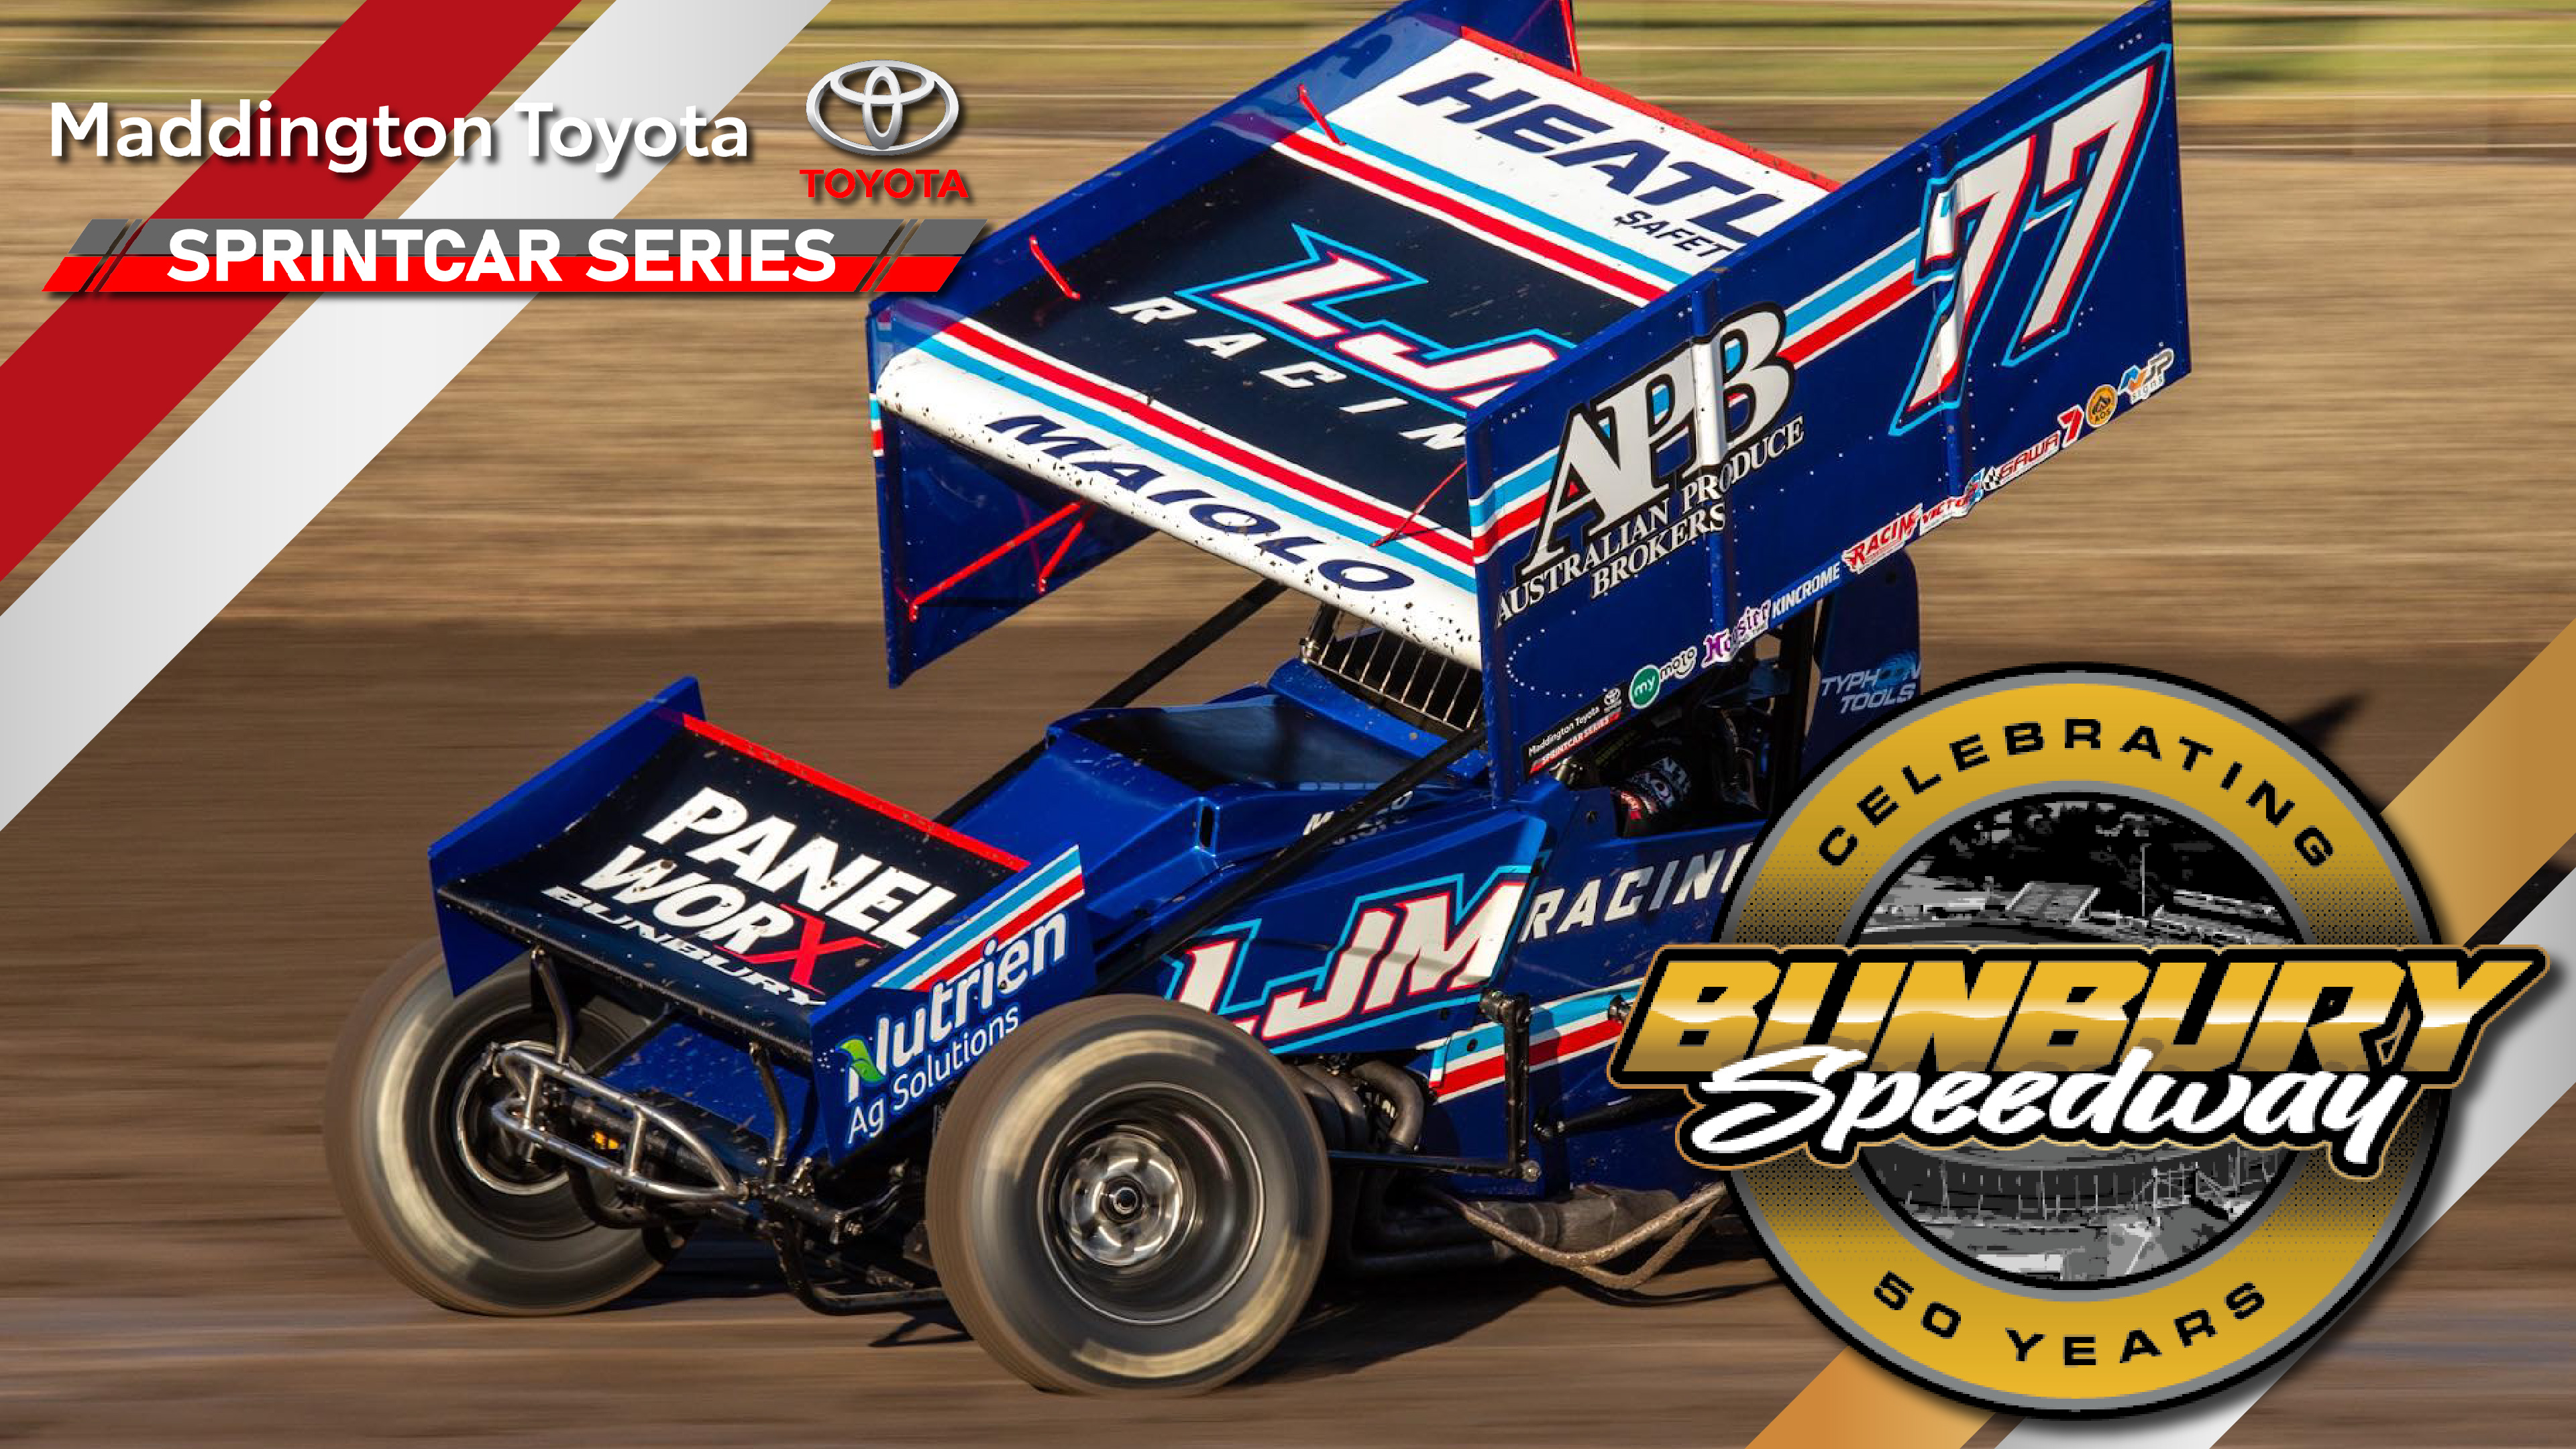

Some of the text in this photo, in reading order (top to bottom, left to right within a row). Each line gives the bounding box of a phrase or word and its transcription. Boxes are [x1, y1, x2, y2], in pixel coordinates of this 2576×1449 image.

[1613, 209, 1734, 260] SAFET
[1897, 54, 2161, 424] 77
[983, 414, 1415, 592] MAIOLO
[1516, 302, 1796, 580] APB
[1496, 415, 1805, 629] AUSTRALIAN PRODUCE
[1591, 502, 1726, 599] BROKERS
[1772, 562, 1841, 619] KINCROME
[1529, 706, 1601, 757] Maddington Toyota
[1839, 683, 1917, 714] TOOLS
[580, 845, 883, 995] WORX
[642, 787, 958, 949] PANEL
[541, 886, 826, 1006] BUNBURY
[844, 911, 1068, 1103] Nutrien
[1174, 877, 1528, 1044] LJM
[847, 1005, 1020, 1144] Ag Solutions
